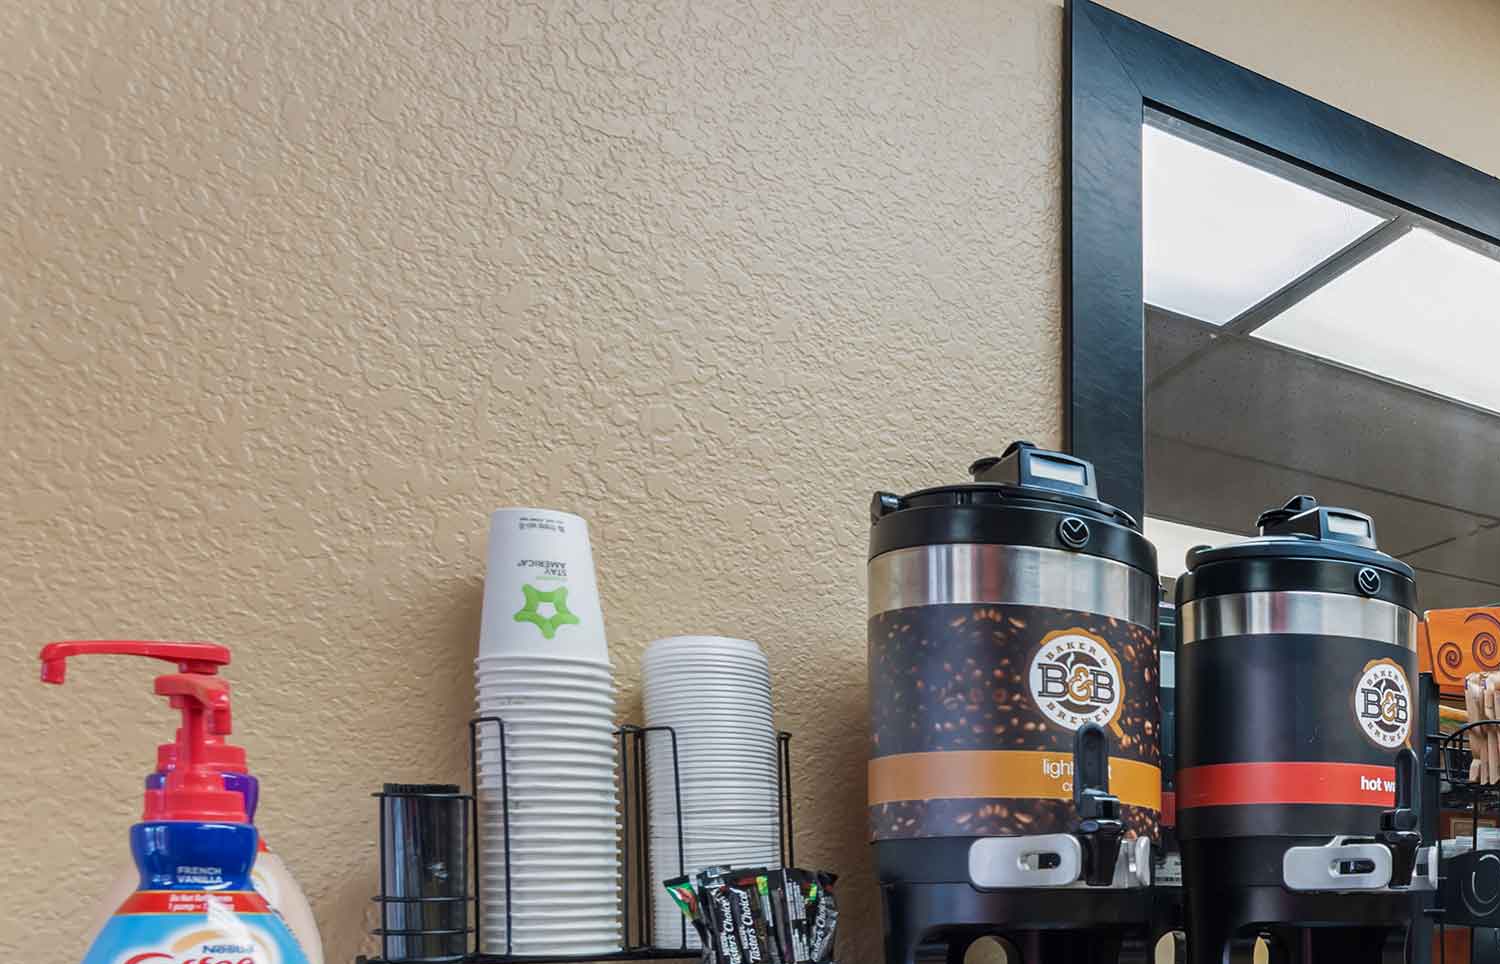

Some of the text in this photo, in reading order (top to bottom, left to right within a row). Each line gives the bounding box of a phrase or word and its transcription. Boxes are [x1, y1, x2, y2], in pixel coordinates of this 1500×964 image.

[1037, 663, 1116, 704] B&B
[1360, 687, 1409, 724] B&B
[1360, 775, 1383, 791] hot
[176, 866, 223, 875] FRENCH
